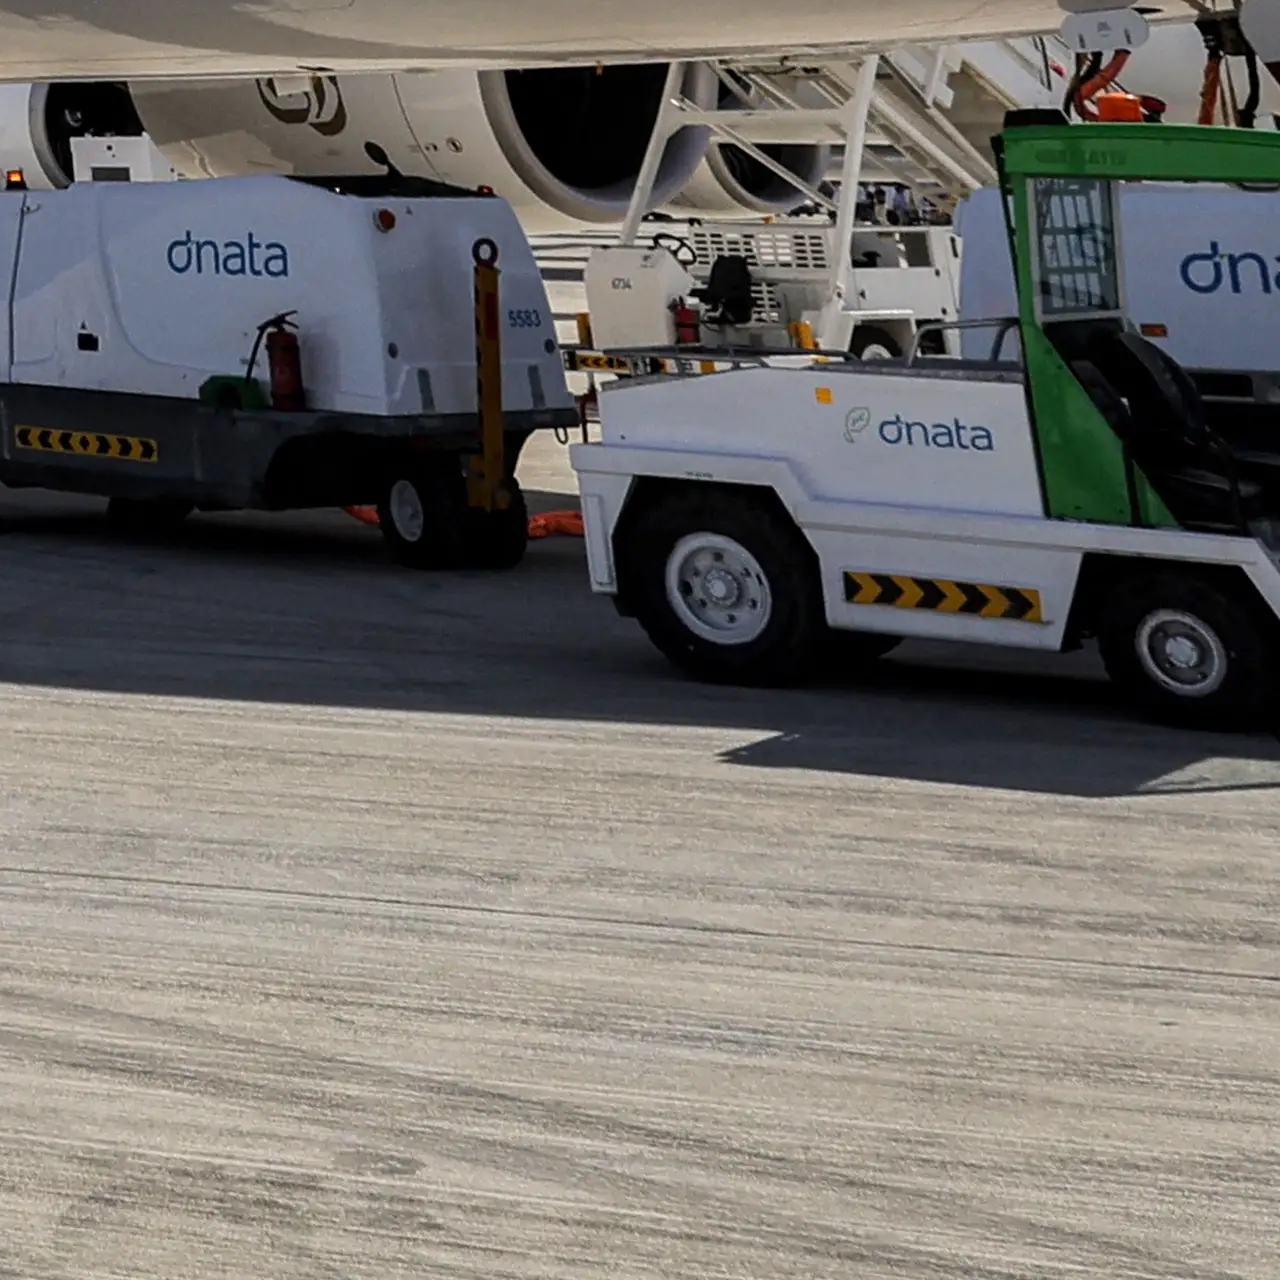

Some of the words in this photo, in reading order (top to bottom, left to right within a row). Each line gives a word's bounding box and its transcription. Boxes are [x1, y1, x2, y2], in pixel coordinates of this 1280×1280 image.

[166, 229, 290, 278] dnata
[507, 310, 542, 328] 5583
[878, 413, 995, 452] dnata
